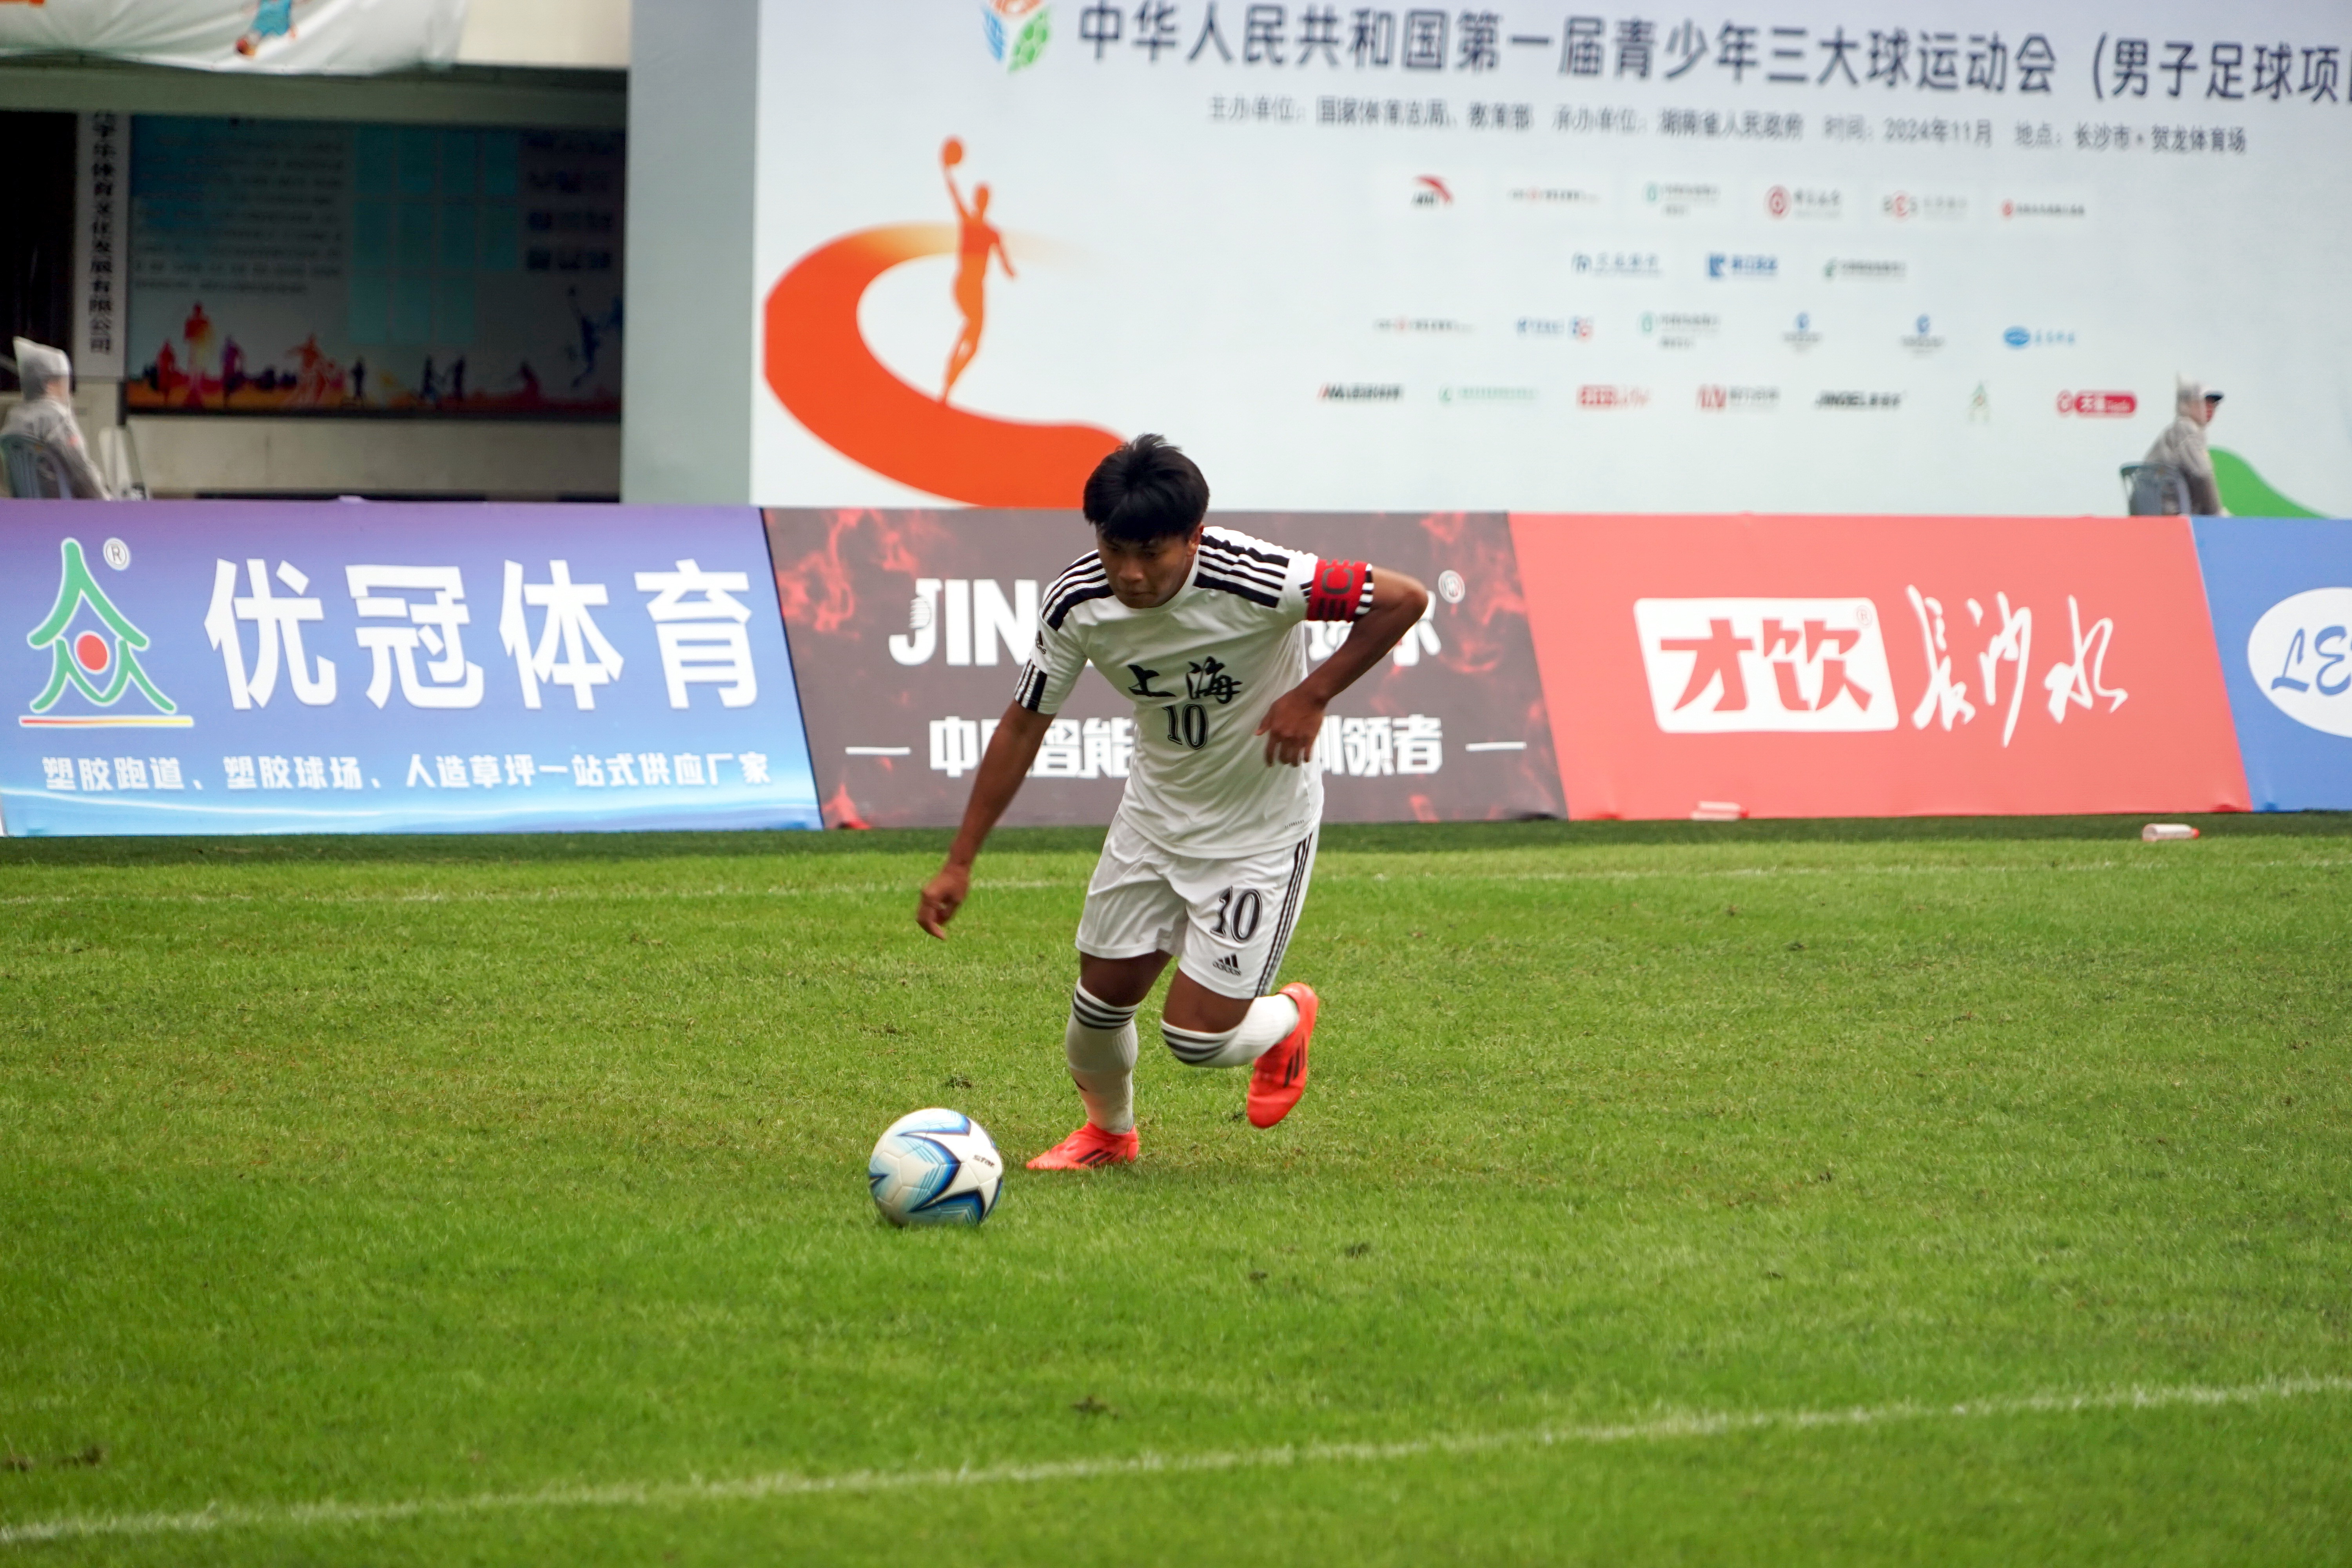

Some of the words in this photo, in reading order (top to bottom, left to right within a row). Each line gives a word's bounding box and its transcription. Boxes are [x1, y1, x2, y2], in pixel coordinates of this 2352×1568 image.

[1078, 1, 2352, 103] 中华人民共和国第一届青少年三大球运动会（男子足球项
[204, 558, 757, 710] 优冠体育
[889, 579, 1040, 666] JIN
[1127, 656, 1243, 704] 上海
[2271, 624, 2352, 696] LE
[1161, 704, 1209, 750] 10
[42, 751, 771, 791] 塑胶跑道、塑胶球场、人造草坪一站式供应厂家
[1210, 885, 1262, 944] 10
